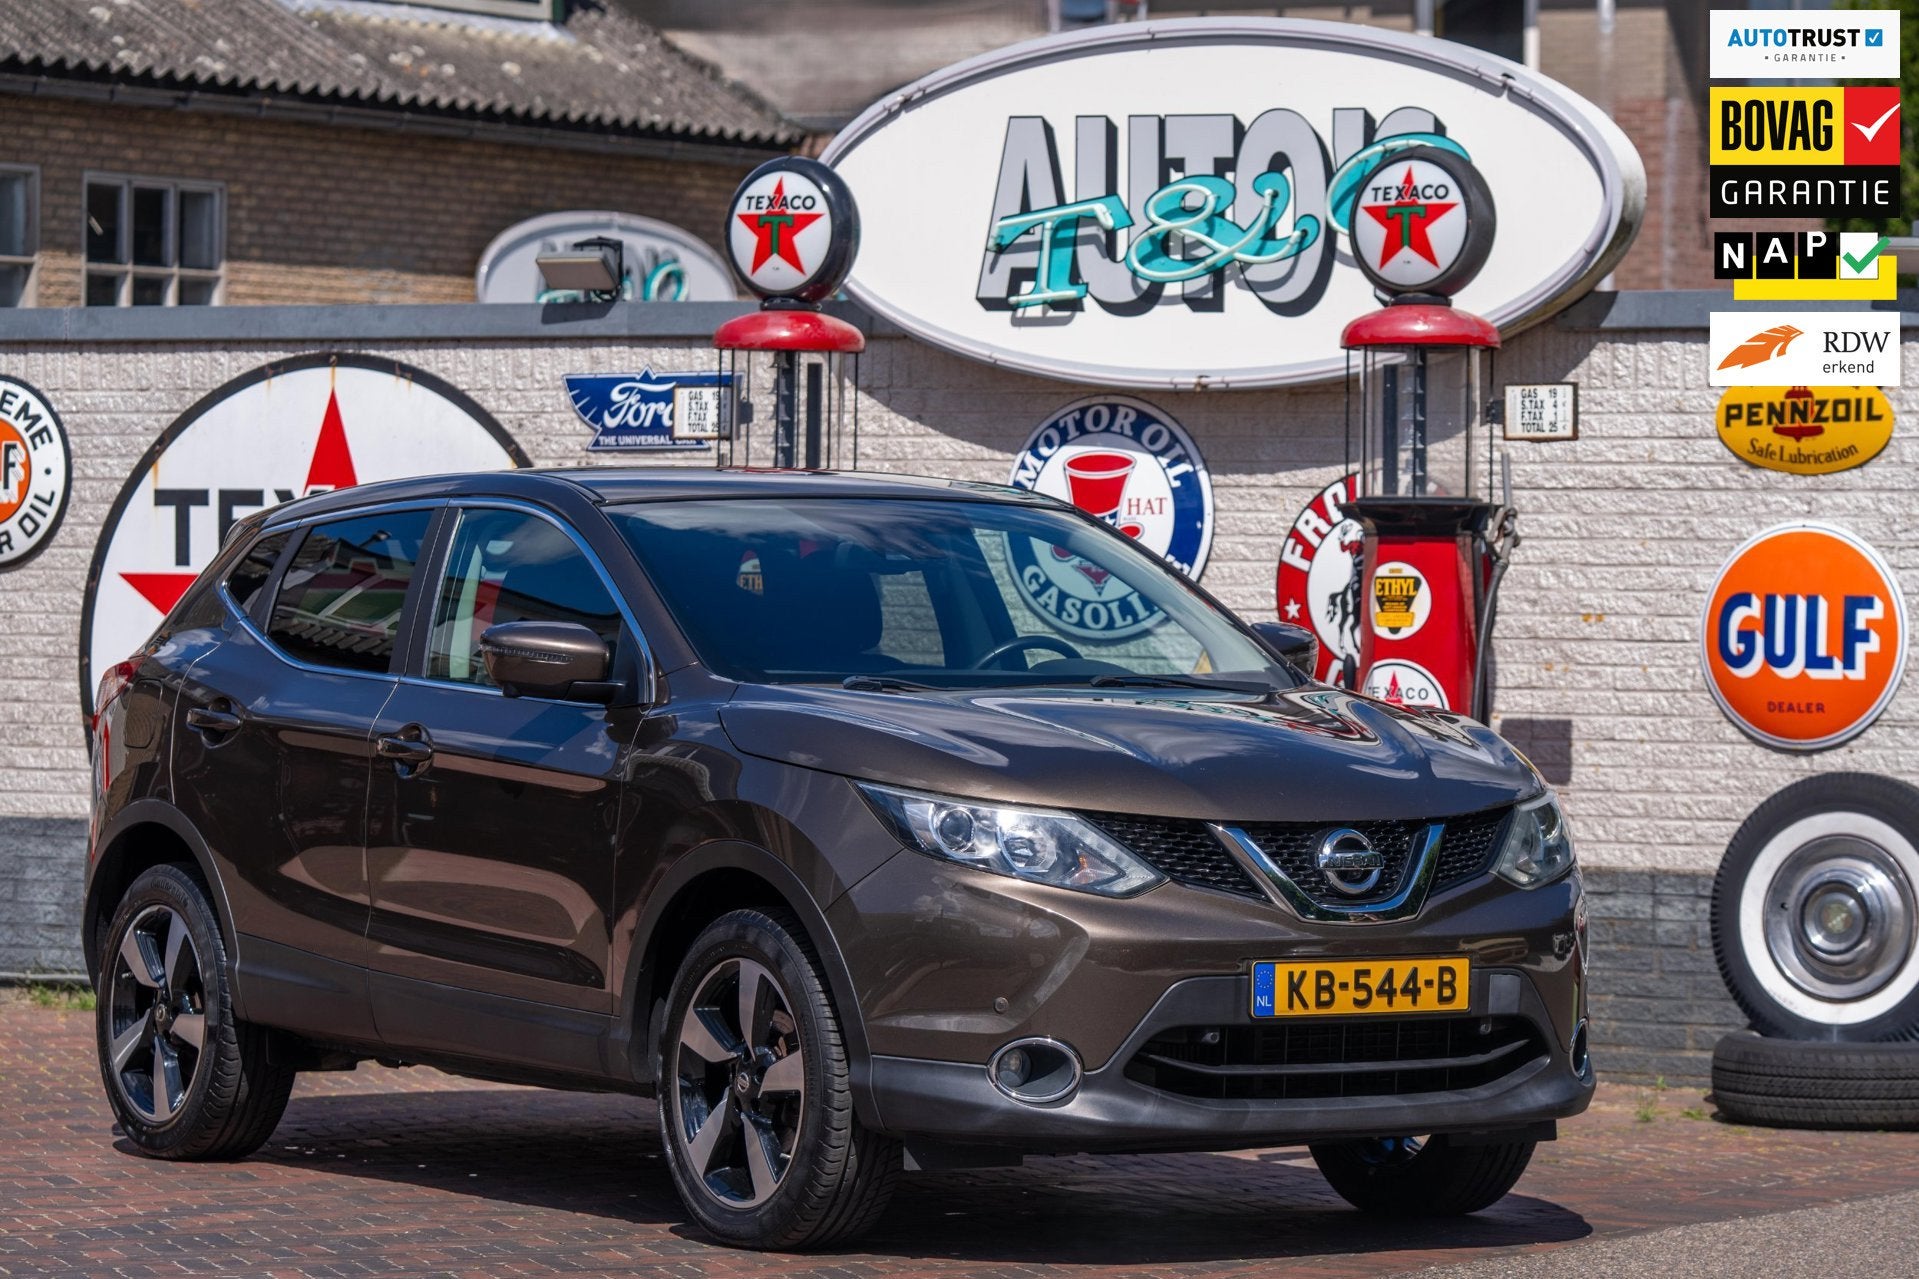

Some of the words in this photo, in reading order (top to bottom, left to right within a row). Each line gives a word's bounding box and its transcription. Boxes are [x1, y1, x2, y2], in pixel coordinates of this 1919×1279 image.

[1371, 183, 1449, 202] TEXACO
[746, 195, 816, 210] TEXACO
[976, 107, 1446, 312] AUTO'
[688, 390, 703, 400] GAS
[1521, 388, 1538, 399] GAS
[1549, 388, 1557, 399] 19
[1521, 400, 1545, 410] S.TAX
[1552, 400, 1558, 409] 4
[1724, 397, 1884, 428] PENNZOIL
[1521, 411, 1544, 421] F.TAX
[688, 422, 708, 432] TOTAL
[1521, 422, 1545, 432] TOTAL
[1548, 422, 1558, 432] 25
[599, 435, 617, 446] THE
[618, 435, 673, 446] UNIVERSAL
[1015, 404, 1138, 488] MOTOR
[1141, 424, 1194, 488] OIL
[1747, 437, 1776, 462] Safe
[1778, 444, 1859, 465] Lubrication
[18, 490, 55, 538] OIL
[1127, 497, 1168, 515] HAT
[1022, 558, 1188, 629] GASOLI
[1375, 578, 1418, 596] ETHYL
[1719, 592, 1882, 678] GULF
[1767, 701, 1825, 713] DEALER
[1287, 966, 1457, 1009] KB-544-B
[1256, 995, 1272, 1007] NL
